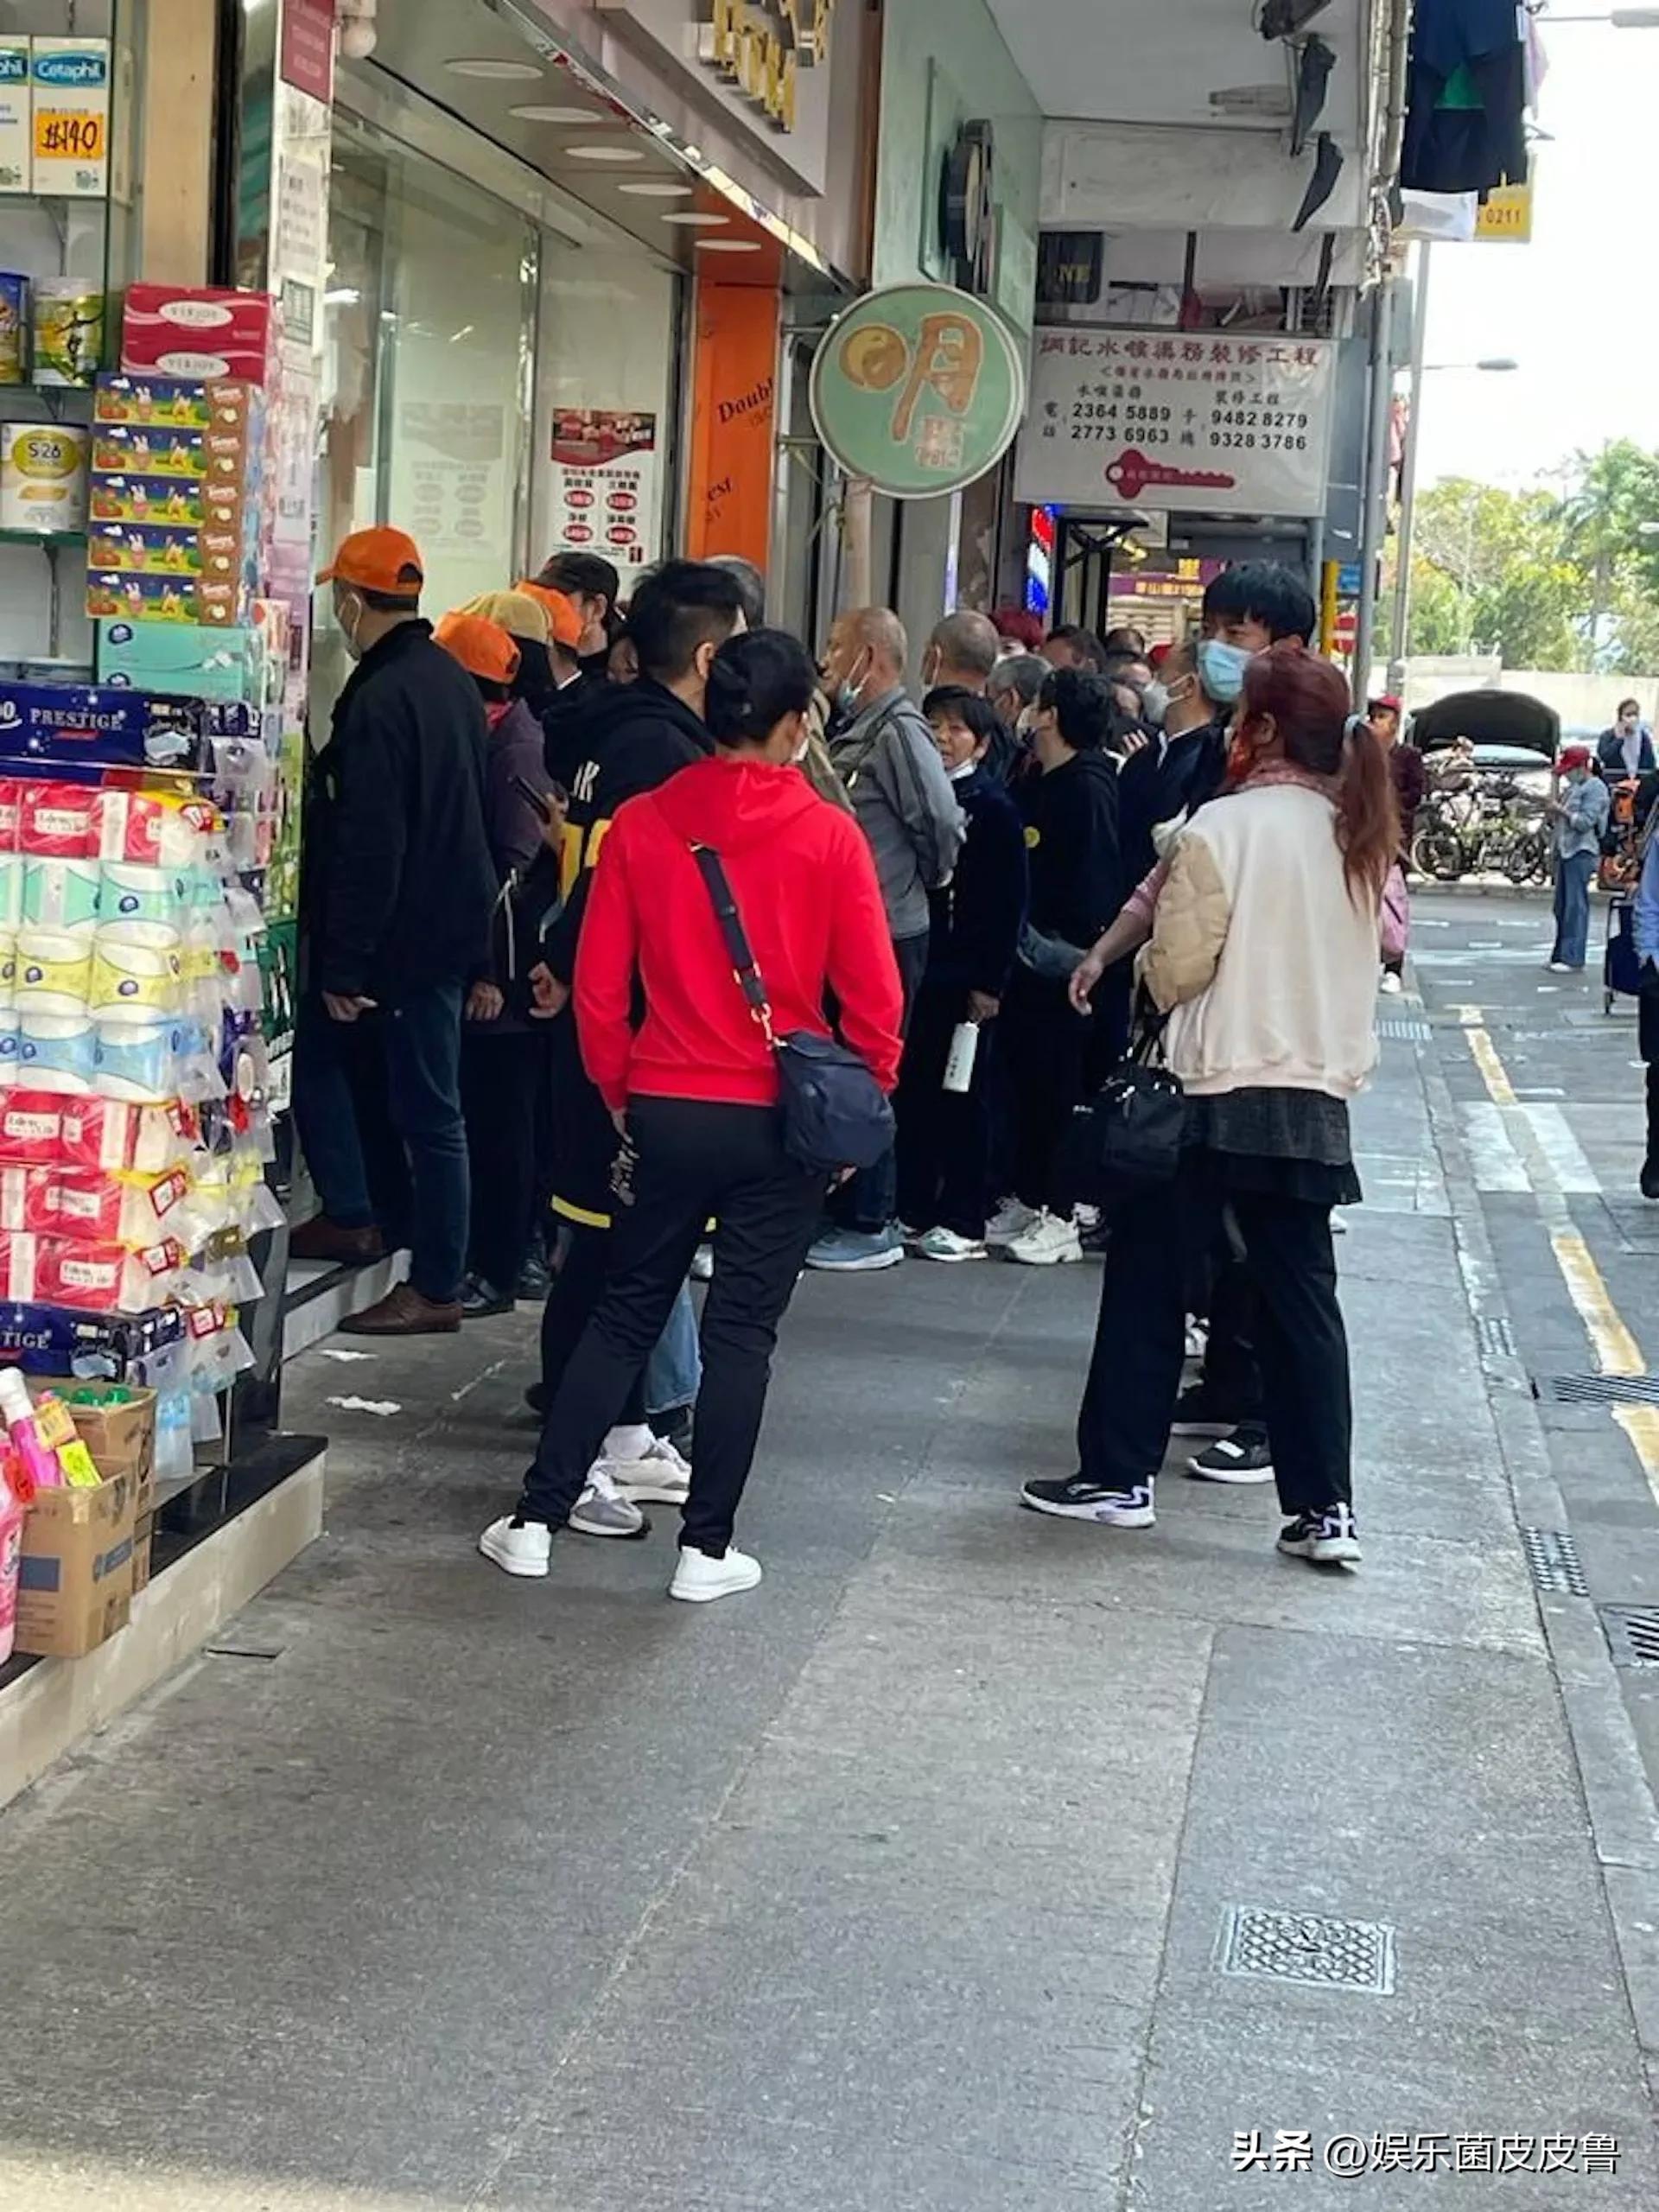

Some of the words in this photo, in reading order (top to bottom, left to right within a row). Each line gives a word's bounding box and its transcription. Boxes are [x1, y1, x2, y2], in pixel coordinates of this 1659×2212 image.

[37, 60, 101, 82] Cetaphil
[1071, 403, 1117, 419] 2364
[1126, 405, 1171, 422] 5889
[1211, 410, 1256, 426] 9482
[1262, 412, 1307, 429] 8279
[1071, 425, 1116, 441] 2773
[1124, 429, 1169, 443] 6963
[1209, 431, 1255, 448] 9328
[1262, 434, 1306, 450] 3786
[29, 706, 124, 732] PRESTIGE
